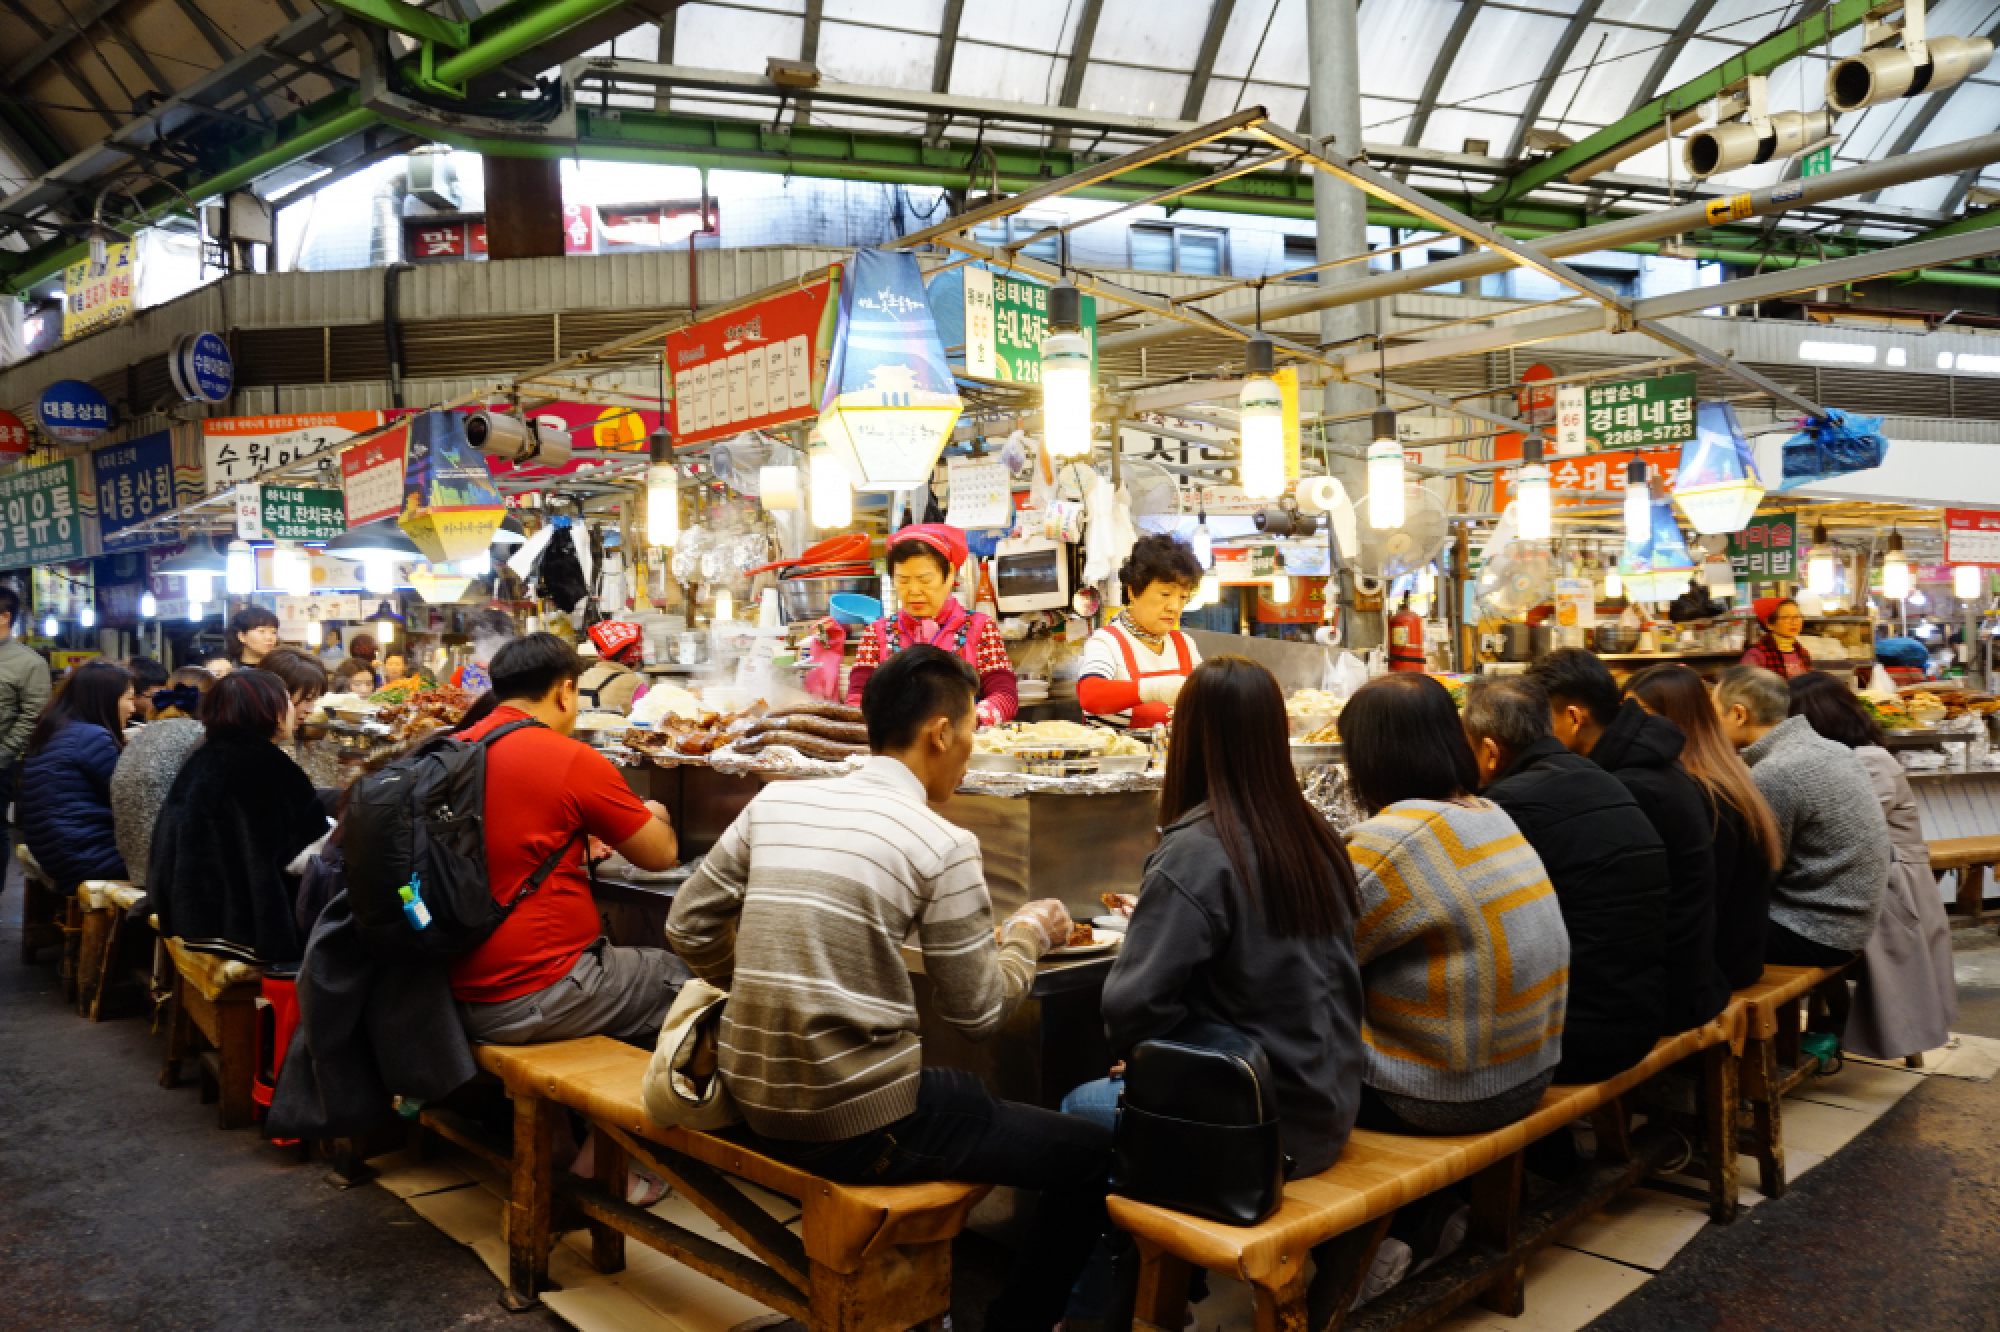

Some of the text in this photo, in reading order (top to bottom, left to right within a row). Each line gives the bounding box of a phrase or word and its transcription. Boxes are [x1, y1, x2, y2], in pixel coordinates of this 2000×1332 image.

[422, 228, 460, 255] 맛
[994, 279, 1047, 311] 경태네집
[43, 401, 107, 421] 대흥상회
[1589, 396, 1693, 431] 경태네집
[1603, 424, 1692, 446] 2268-5723
[101, 463, 172, 520] 대흥상회
[265, 490, 304, 504] 하니네
[242, 505, 257, 517] 64
[1730, 549, 1793, 578] 보리밥
